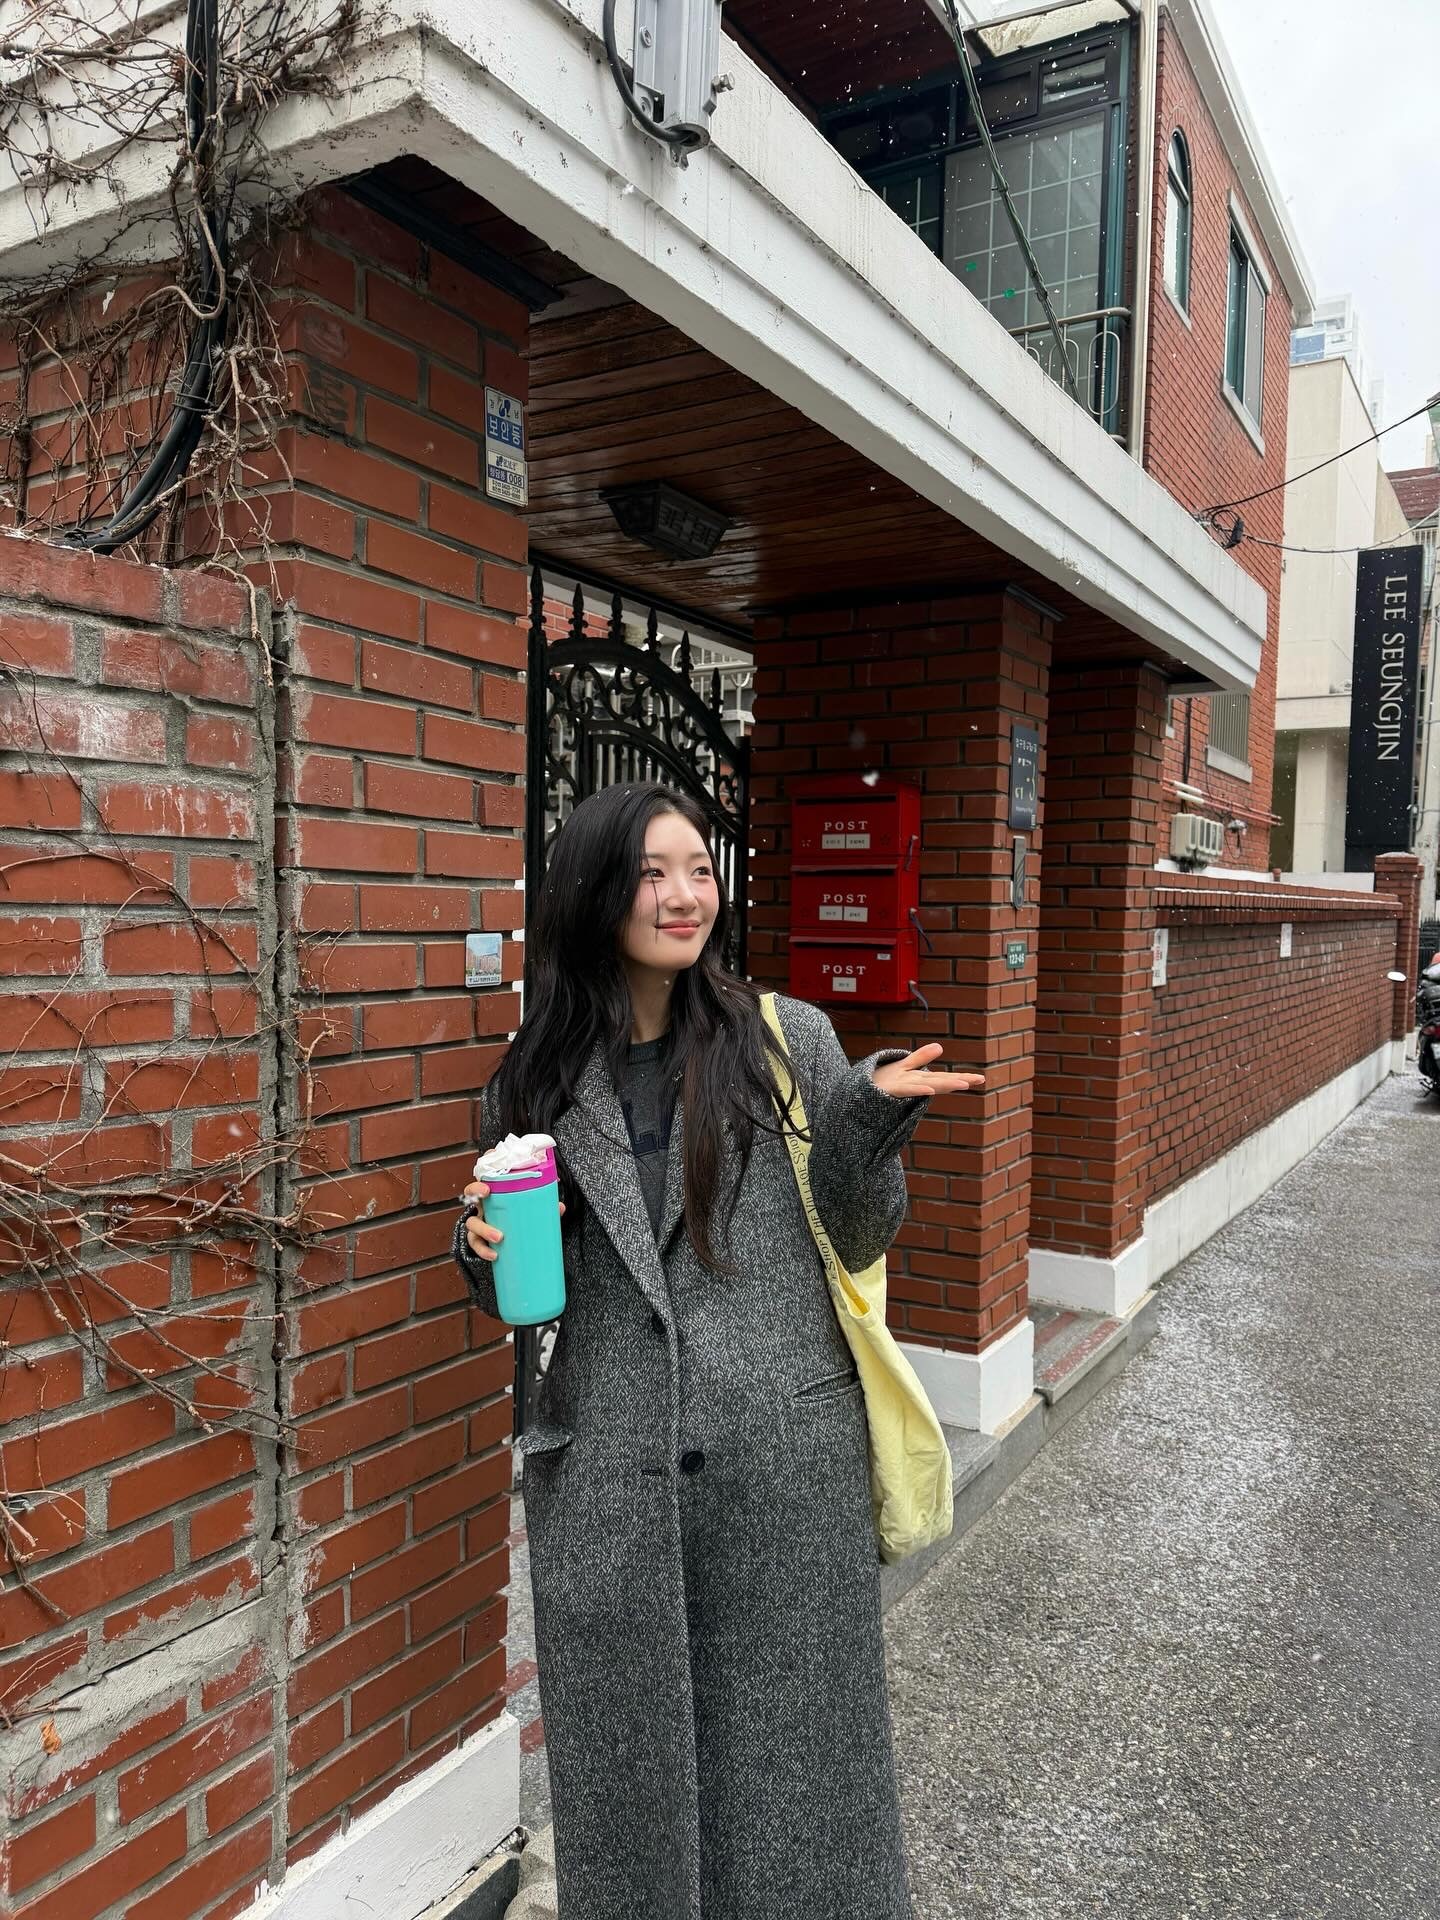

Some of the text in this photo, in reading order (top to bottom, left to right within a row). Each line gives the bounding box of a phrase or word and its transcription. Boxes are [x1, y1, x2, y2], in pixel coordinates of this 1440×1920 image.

[489, 415, 520, 446] 보안등
[508, 473, 522, 486] 008
[1373, 576, 1407, 761] LEE SEUNGJIN
[824, 820, 868, 831] POST
[823, 894, 867, 904] POST
[822, 964, 866, 975] POST
